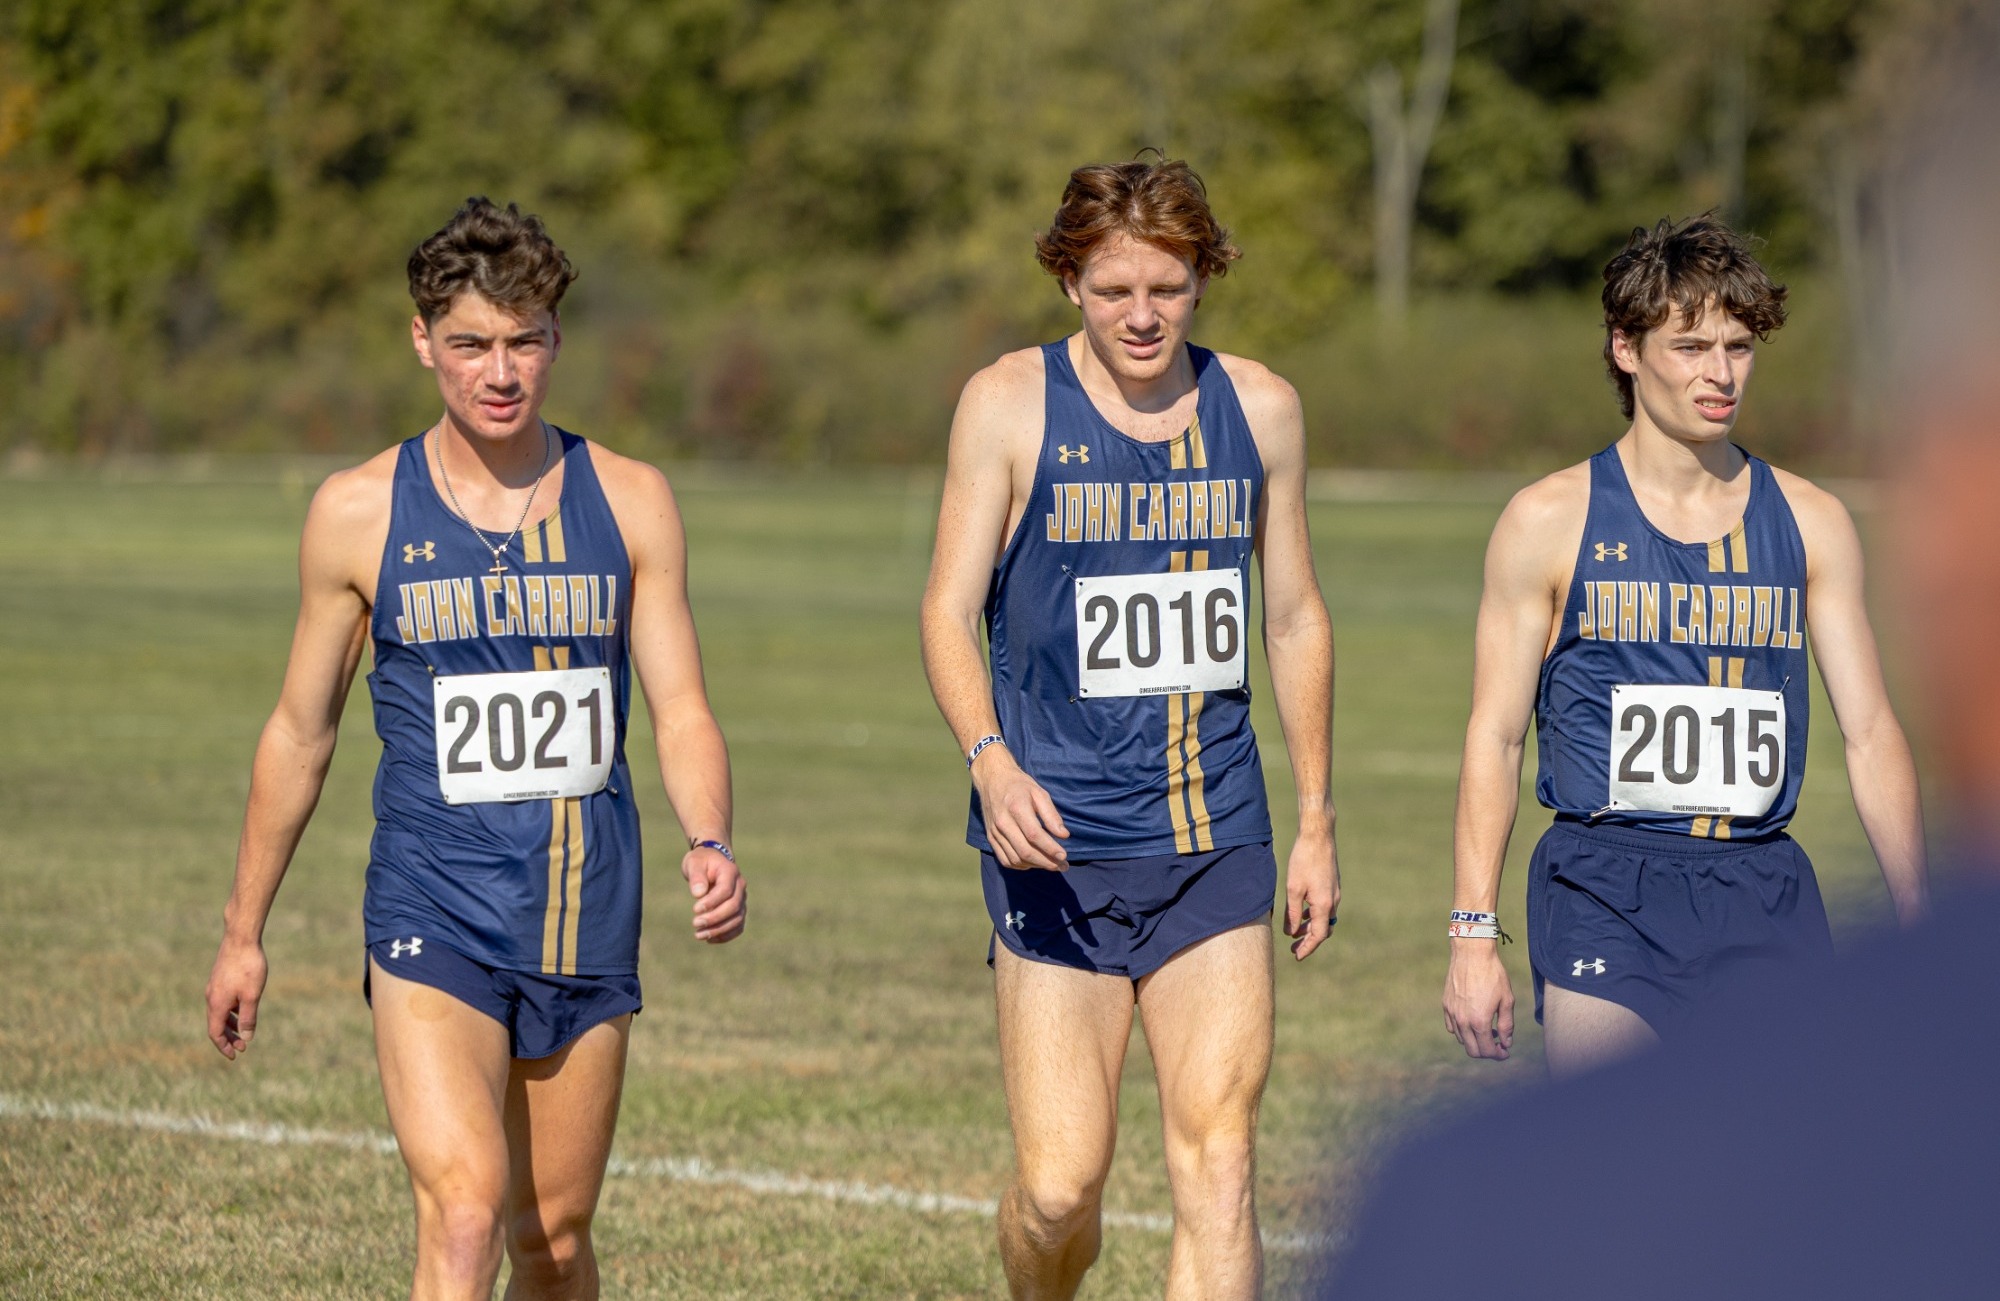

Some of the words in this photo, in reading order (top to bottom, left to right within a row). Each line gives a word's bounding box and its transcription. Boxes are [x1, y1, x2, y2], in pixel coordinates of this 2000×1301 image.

[1046, 483, 1122, 543] JOHN
[1129, 479, 1252, 541] CARROLL
[396, 577, 479, 645] JOHN
[480, 575, 617, 637] CARROLL
[1084, 587, 1239, 671] 2016
[1578, 581, 1660, 643] JOHN
[1669, 582, 1803, 650] CARROLL
[444, 687, 602, 774] 2021
[1617, 703, 1780, 788] 2015
